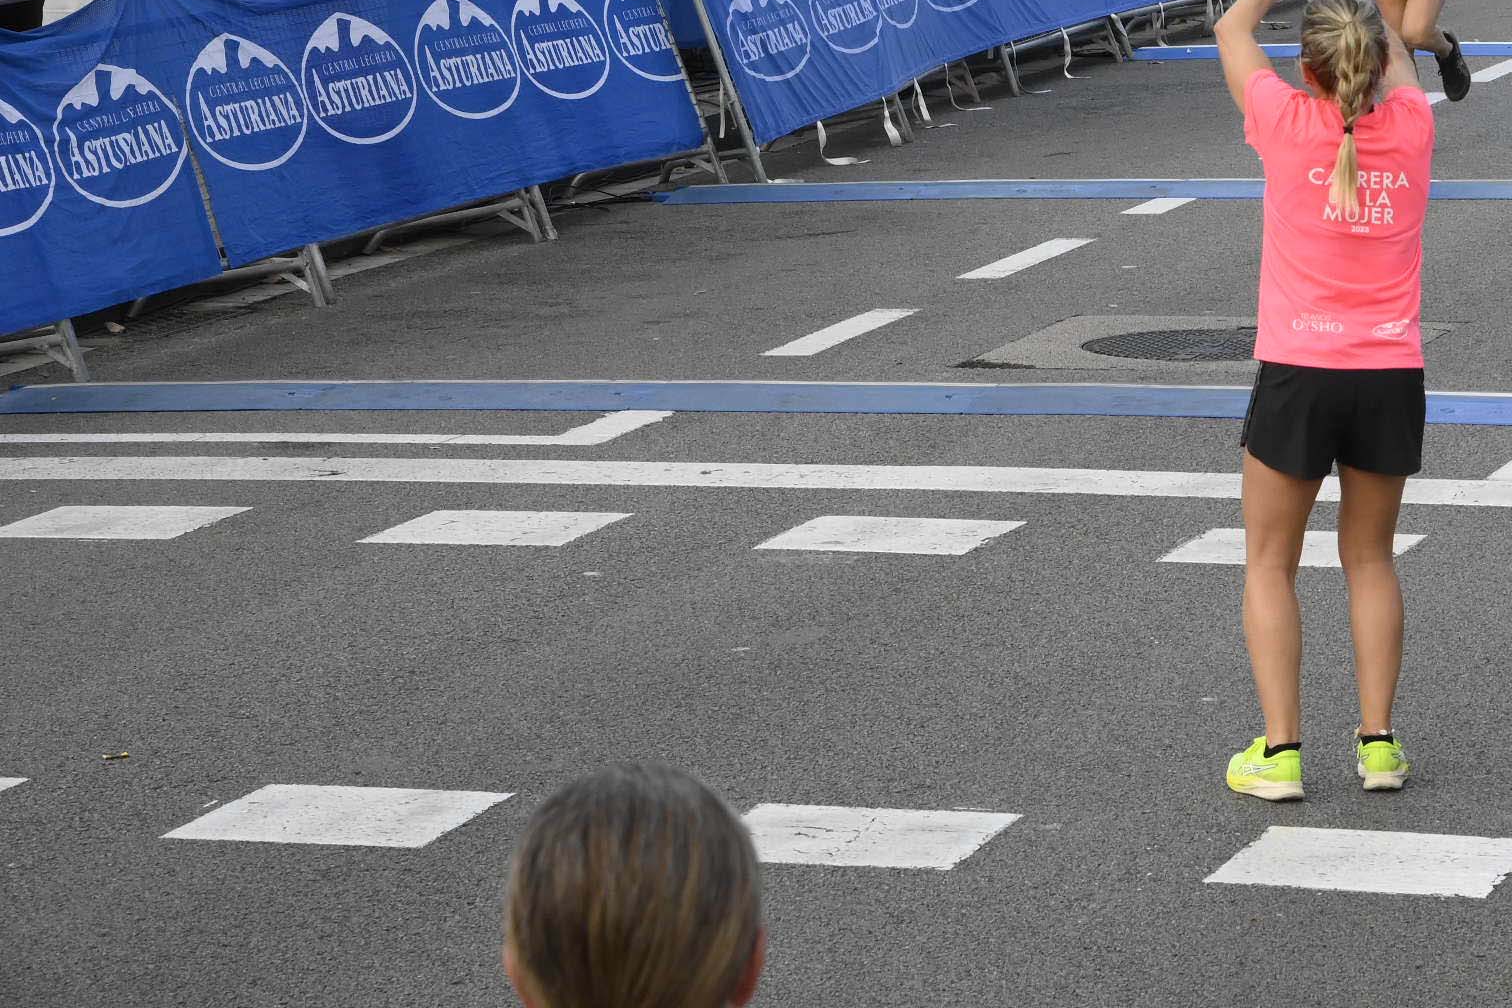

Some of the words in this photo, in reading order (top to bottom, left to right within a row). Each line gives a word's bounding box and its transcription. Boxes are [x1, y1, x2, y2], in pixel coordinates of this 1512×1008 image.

[528, 22, 556, 36] CENTRAL
[557, 17, 589, 32] LECHERA
[434, 37, 469, 52] CENTRAL
[469, 30, 502, 47] LECHERA
[518, 28, 605, 75] ASTURIANA
[321, 58, 358, 78] CENTRAL
[358, 48, 397, 69] LECHERA
[424, 45, 516, 93] ASTURIANA
[209, 83, 247, 98] CENTRAL
[248, 74, 287, 90] LECHERA
[312, 66, 412, 119] ASTURIANA
[196, 91, 302, 143] ASTURIANA
[66, 119, 179, 180] ASTURIANA
[1307, 167, 1410, 189] CARERA
[1365, 189, 1392, 207] LA
[1322, 205, 1395, 225] MUJER
[1292, 318, 1344, 334] OYSHO
